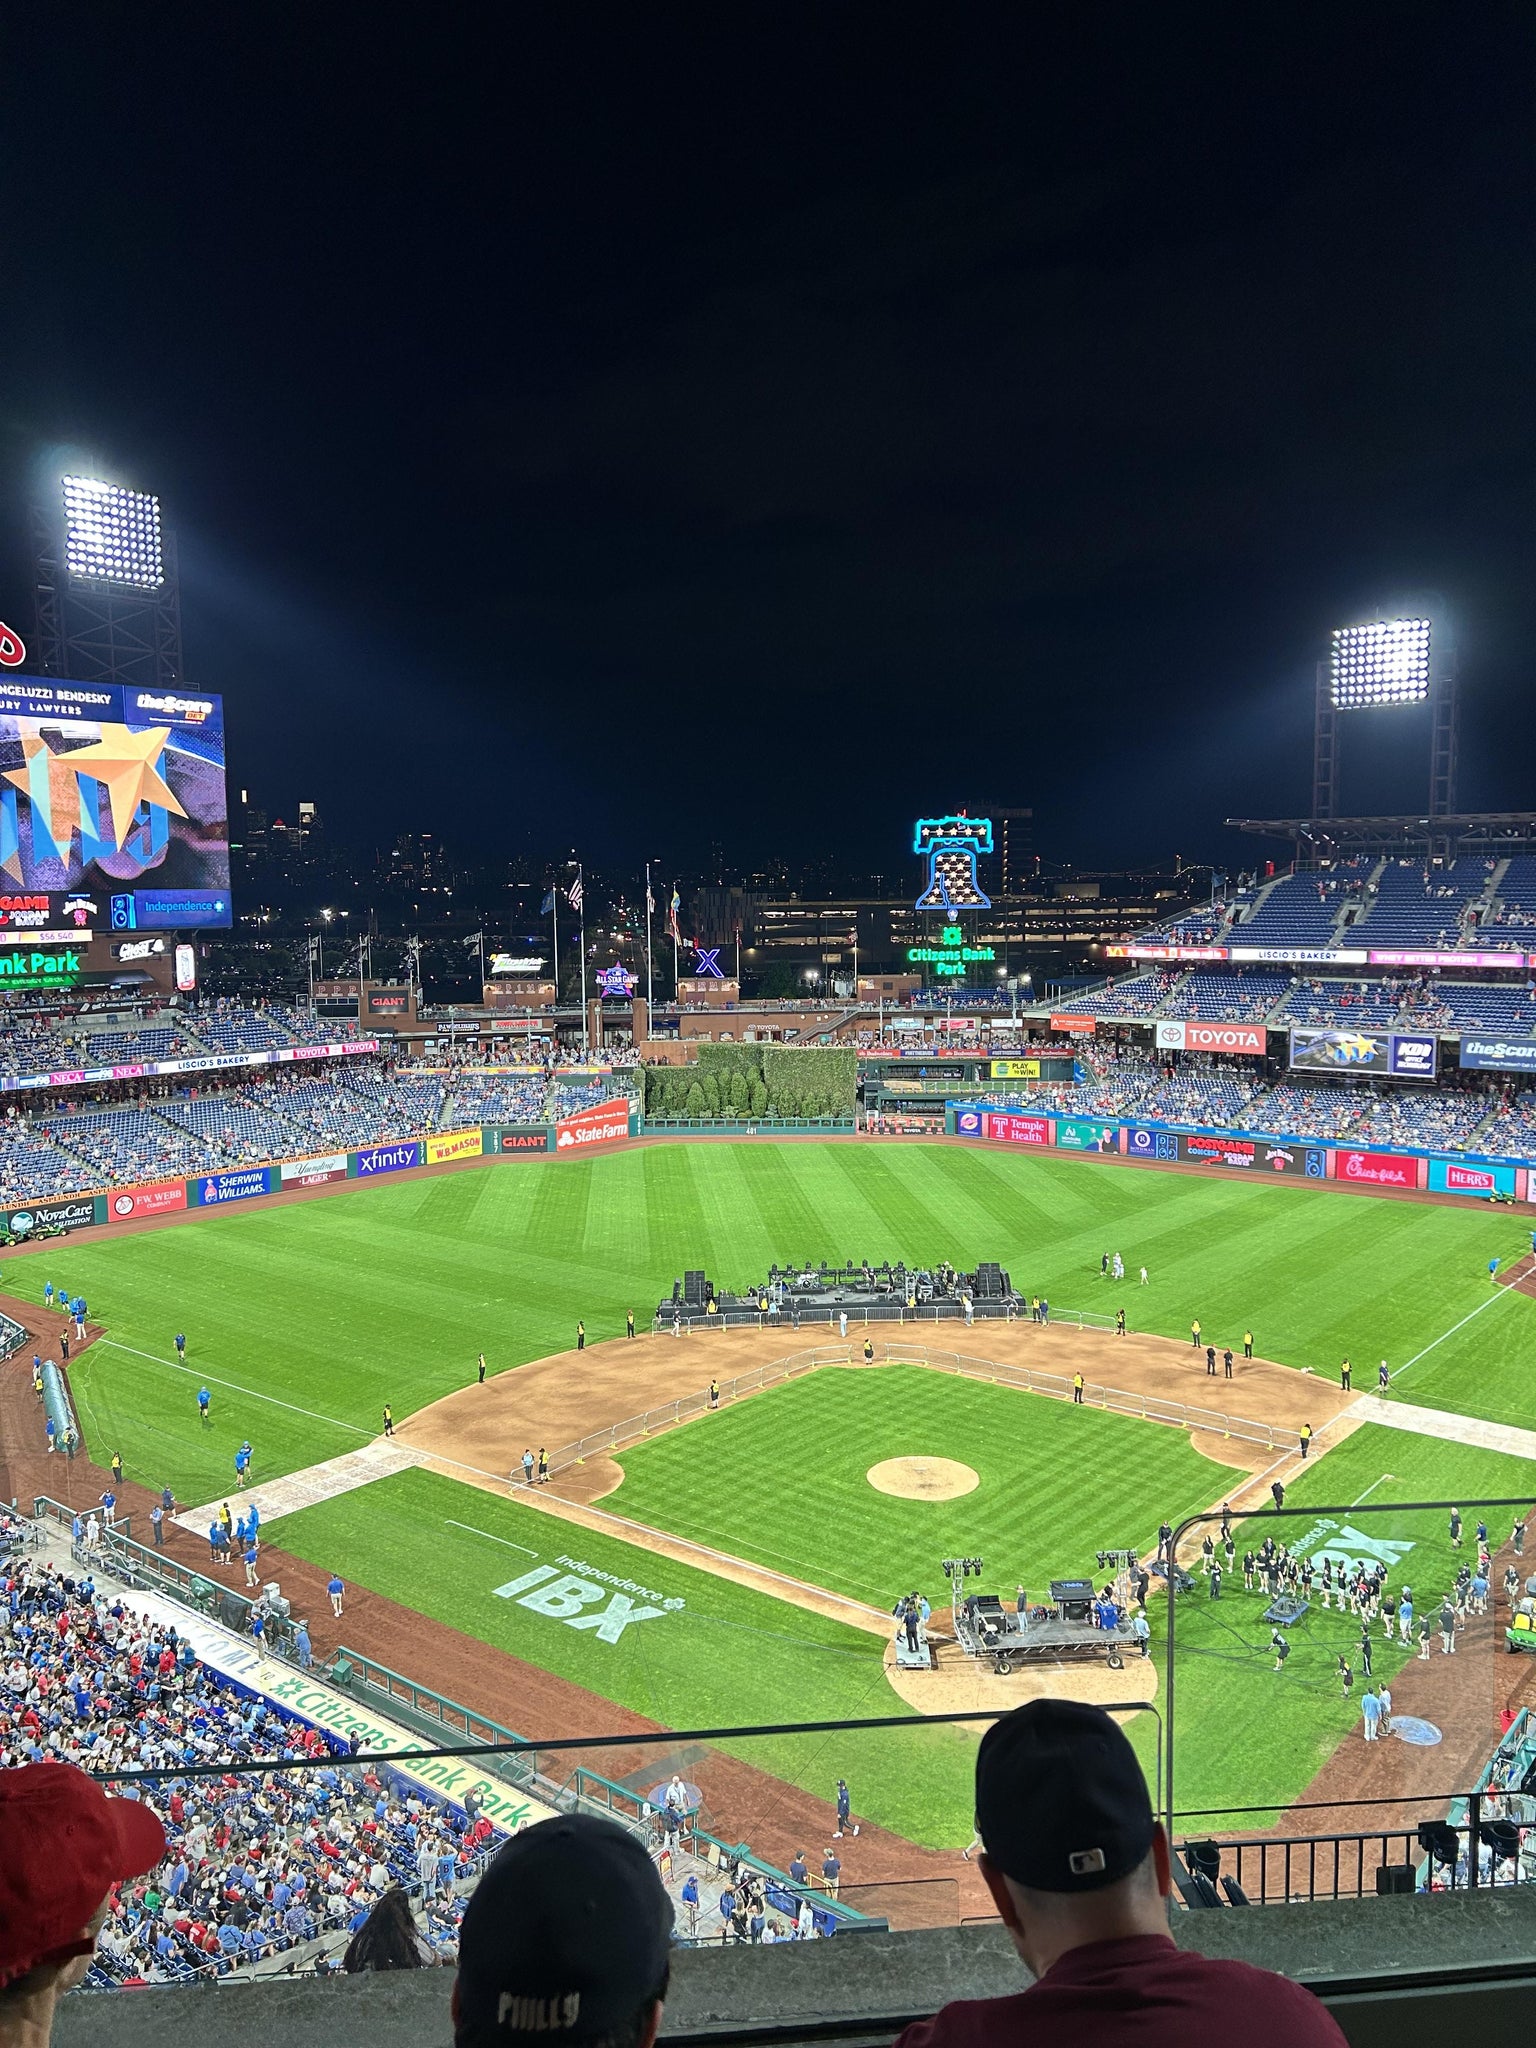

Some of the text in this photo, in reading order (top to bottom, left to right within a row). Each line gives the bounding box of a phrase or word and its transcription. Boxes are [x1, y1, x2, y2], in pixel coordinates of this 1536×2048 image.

[57, 690, 111, 704] BENDESKY
[137, 693, 213, 714] theScore
[29, 703, 82, 715] LAWYERS
[145, 901, 212, 913] Independence
[908, 948, 996, 961] Citizens Bank
[1259, 951, 1337, 960] LISCIO'S BAKERY
[31, 950, 80, 974] Park
[937, 962, 966, 975] Park
[371, 998, 405, 1006] GIANT
[1190, 1028, 1259, 1047] TOYOTA
[295, 1047, 328, 1057] TOYOTA
[344, 1043, 375, 1052] TOYOTA
[178, 1055, 250, 1070] LISCIO'S BAKERY
[115, 1066, 143, 1077] NECA
[54, 1073, 82, 1084] NECA
[1011, 1119, 1044, 1132] Temple
[502, 1136, 546, 1147] GIANT
[1011, 1130, 1042, 1142] Health
[1187, 1137, 1255, 1154] POSTGAME
[361, 1147, 415, 1171] xfinity
[294, 1159, 336, 1177] Yuengling
[38, 1192, 81, 1204] ASPLUNDH
[88, 1185, 129, 1196] ASPLUNDH
[135, 1177, 175, 1188] ASPLUNDH
[182, 1169, 218, 1180] ASPLUNDH
[225, 1163, 260, 1173] ASPLUNDH
[266, 1157, 300, 1167] ASPLUNDH
[306, 1150, 339, 1160] ASPLUNDH
[219, 1172, 263, 1188] SHERWIN
[1451, 1172, 1489, 1187] HERR'S
[154, 1190, 182, 1202] WEBB
[146, 1200, 171, 1210] COMPANY
[35, 1204, 93, 1224] NovaCare
[554, 1554, 663, 1602] Independence
[491, 1564, 668, 1645] IBX
[295, 1691, 398, 1753] Citizens
[463, 1780, 533, 1829] Park
